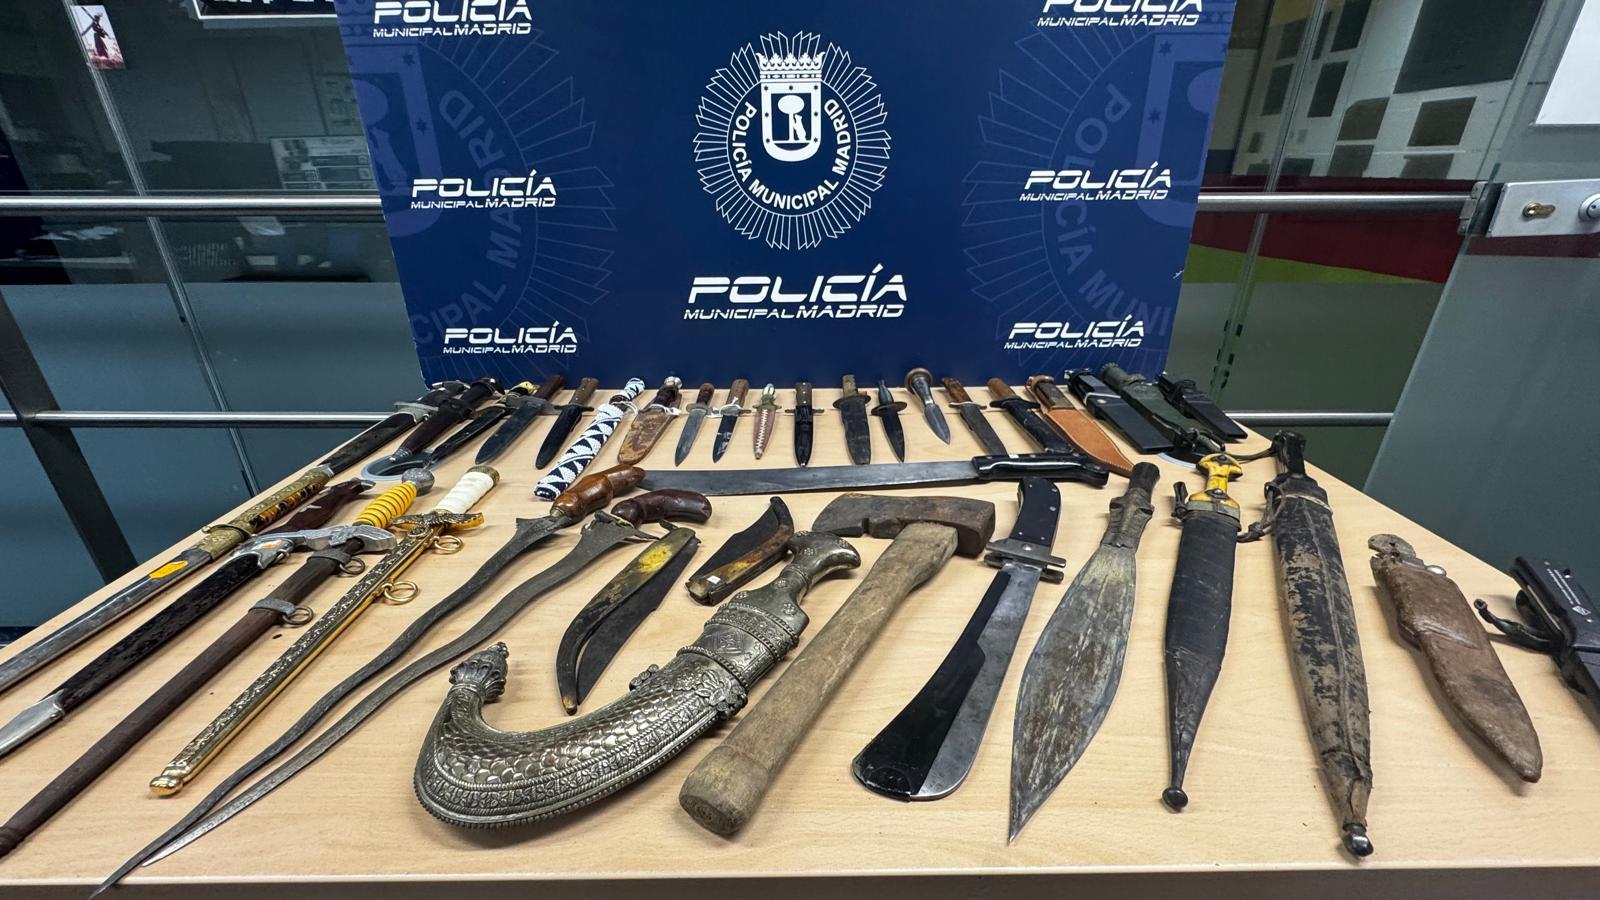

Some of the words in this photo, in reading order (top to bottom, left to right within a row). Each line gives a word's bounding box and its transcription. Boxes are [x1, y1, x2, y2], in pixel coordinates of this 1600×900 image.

[732, 102, 758, 183] POLICÍA
[748, 179, 839, 210] MUNICIPAL
[824, 99, 851, 176] MADRID
[412, 169, 556, 197] POLICÍA
[1025, 161, 1171, 189] POLICÍA
[1055, 83, 1132, 275] POLCÍA
[688, 264, 907, 303] POLICÍA
[445, 321, 577, 344] POLICÍA
[1009, 315, 1144, 338] POLICÍA
